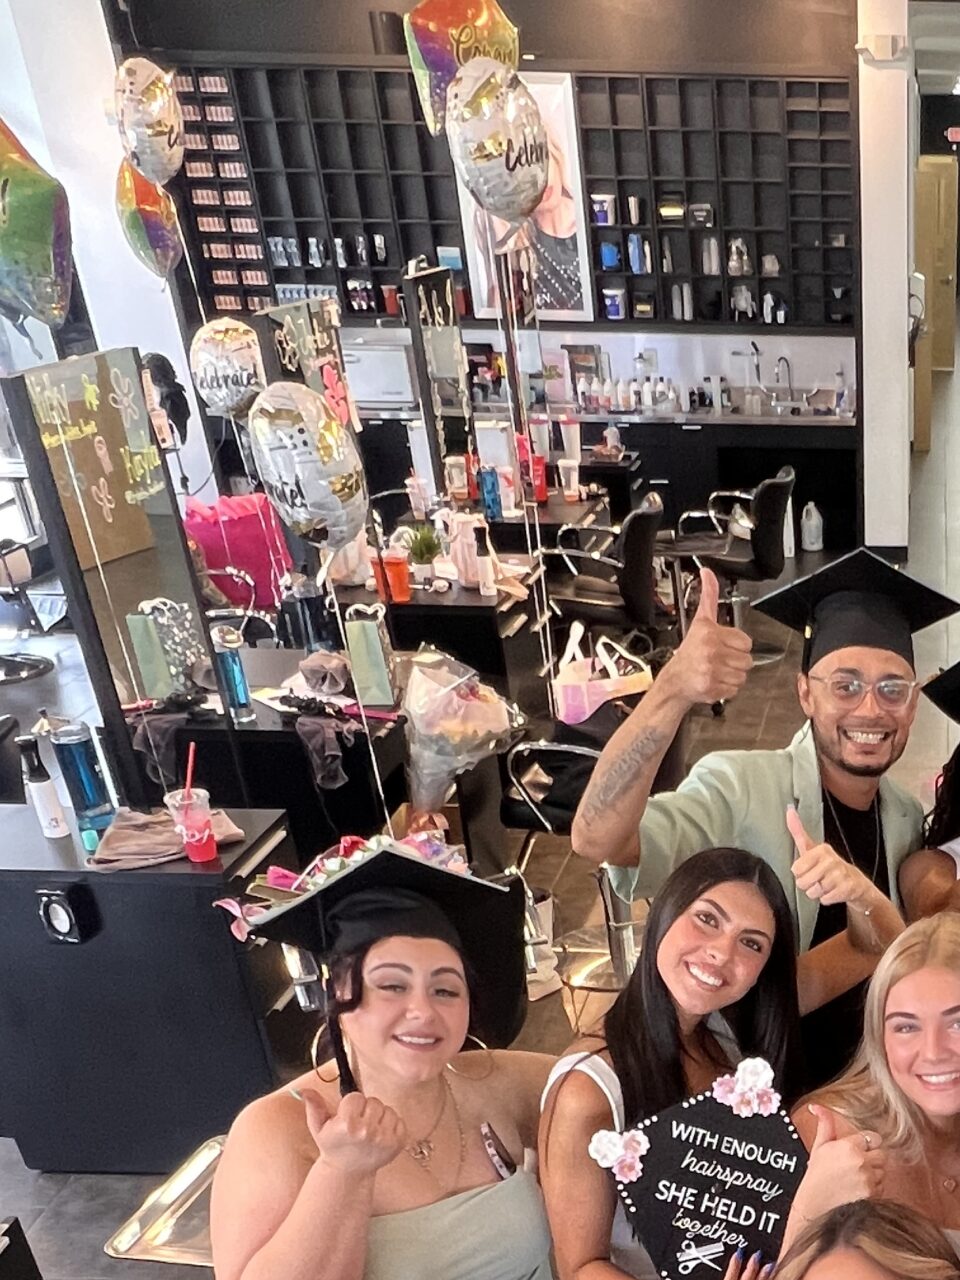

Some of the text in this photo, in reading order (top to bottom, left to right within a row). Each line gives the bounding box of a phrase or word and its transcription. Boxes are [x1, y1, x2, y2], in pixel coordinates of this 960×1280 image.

[671, 1120, 797, 1173] WITH ENOUGH
[680, 1149, 783, 1202] hairspray
[655, 1179, 780, 1233] SHE HELD IT
[672, 1207, 748, 1248] together
